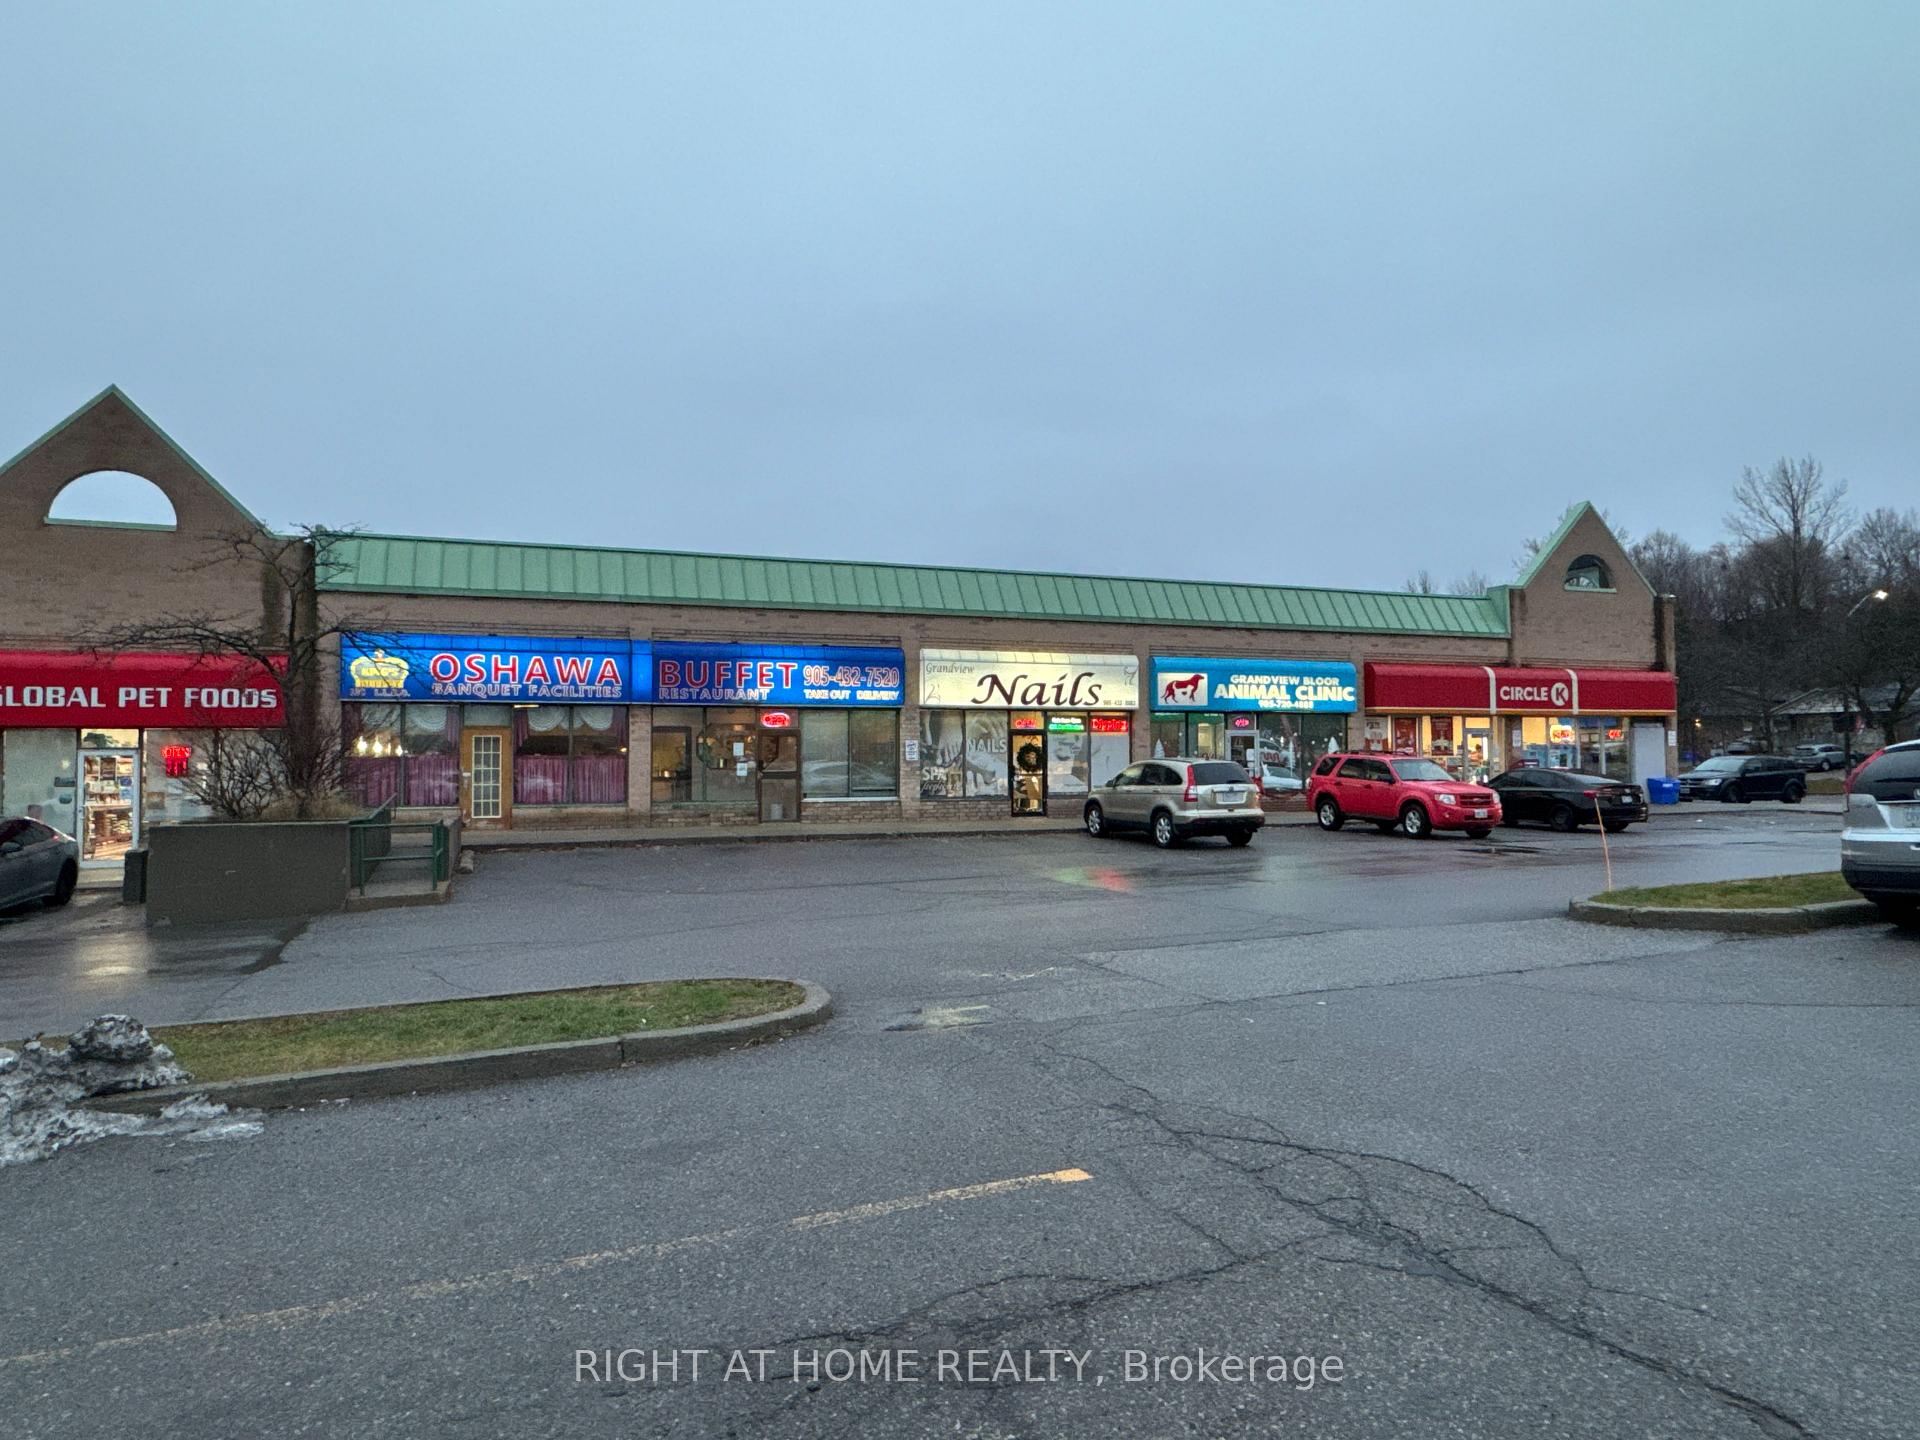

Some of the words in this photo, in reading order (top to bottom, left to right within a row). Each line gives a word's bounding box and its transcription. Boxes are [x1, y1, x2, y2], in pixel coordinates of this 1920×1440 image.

[430, 653, 622, 686] OSHAWA
[660, 660, 798, 689] BUFFET
[803, 664, 899, 688] 905-432-7520
[926, 662, 975, 674] Grandview
[971, 672, 1102, 706] Nails
[1230, 675, 1300, 685] GRANDVIEW
[1303, 676, 1340, 686] BLOOR
[0, 685, 106, 708] LOBAL
[118, 687, 172, 708] PET
[184, 688, 278, 709] FOODS
[431, 682, 523, 699] BANQUET
[528, 684, 622, 699] FACILITIES
[659, 688, 771, 700] RESTAURANT
[803, 689, 829, 700] TAKE
[829, 690, 852, 700] OUT
[1214, 683, 1291, 700] ANIMAL
[1295, 686, 1355, 702] CLINIC
[1500, 686, 1549, 701] CIRCLE
[1553, 685, 1567, 705] K
[967, 738, 1008, 754] NAILS
